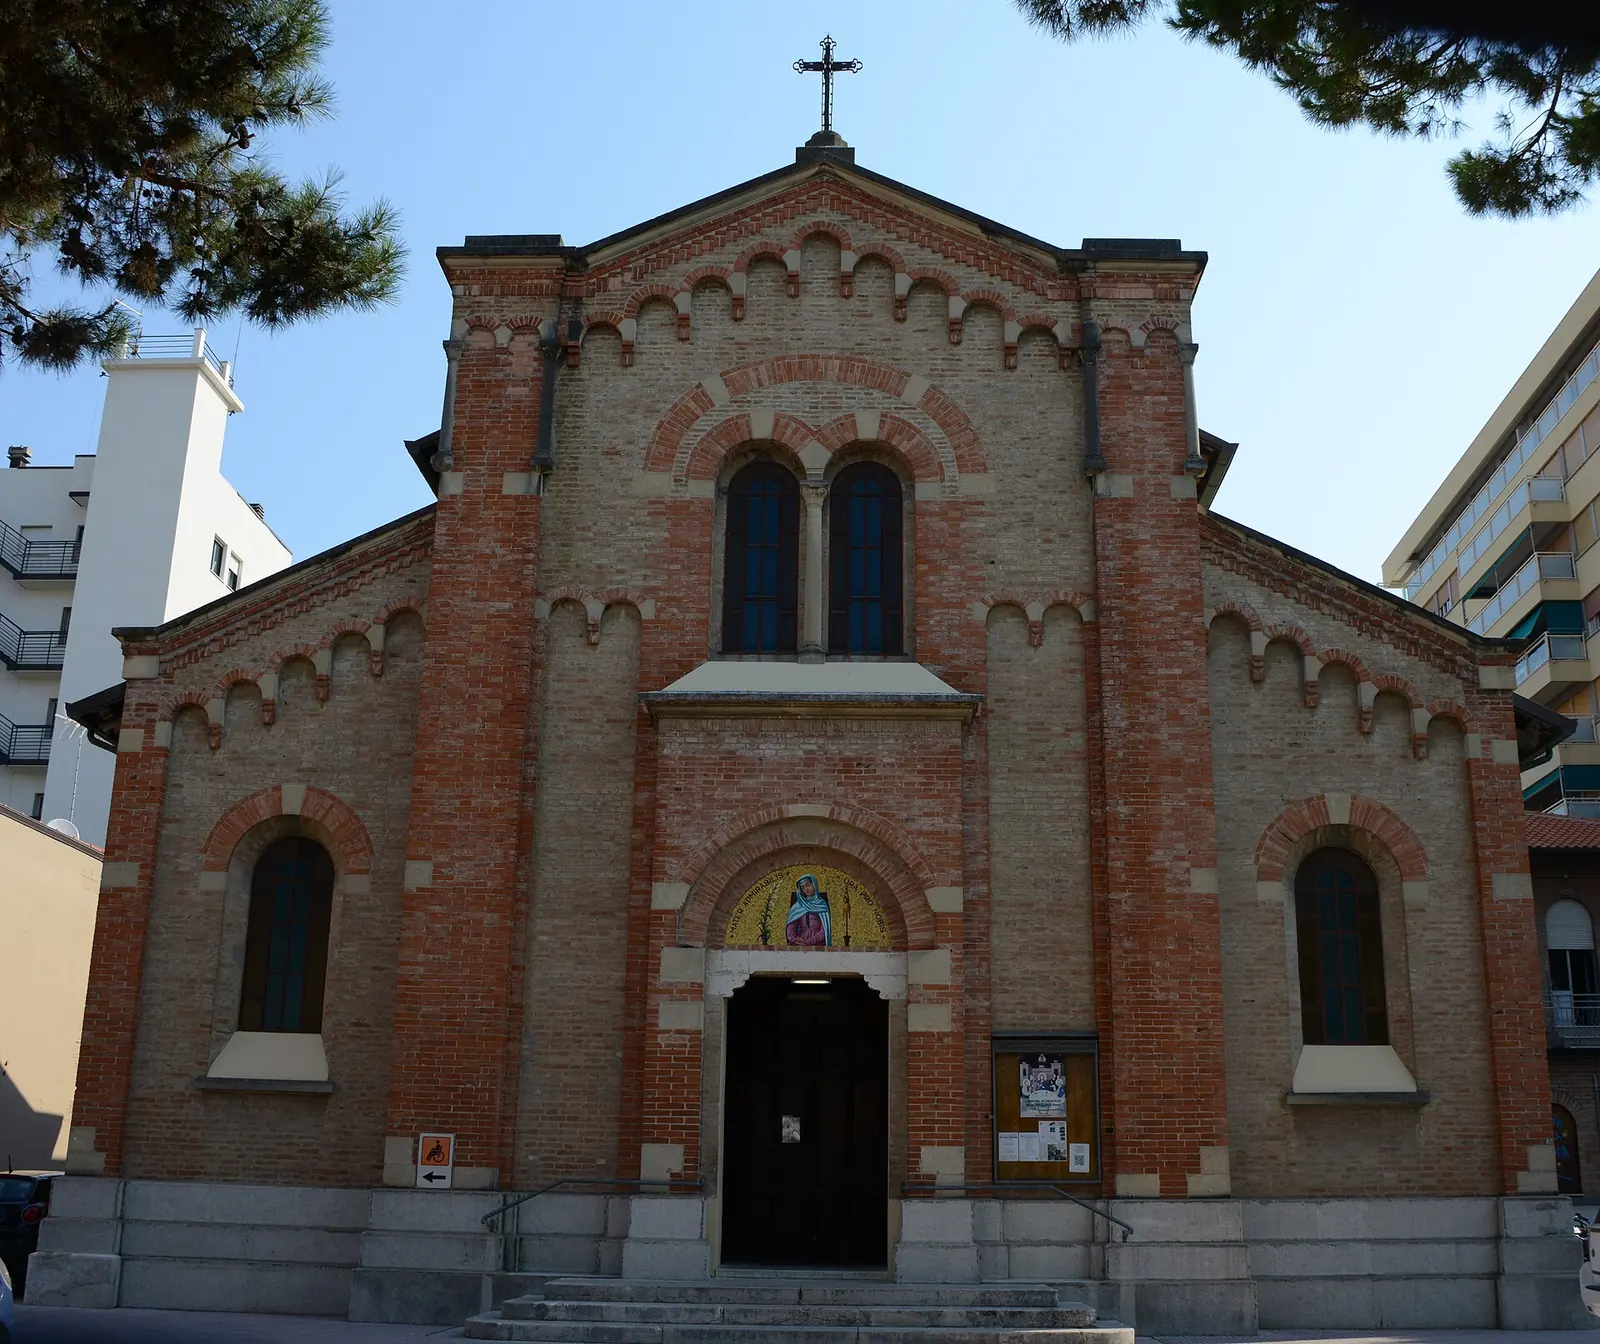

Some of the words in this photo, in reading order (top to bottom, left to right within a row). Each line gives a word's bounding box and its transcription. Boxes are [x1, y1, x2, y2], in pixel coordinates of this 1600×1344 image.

[730, 908, 744, 934] MATER
[742, 872, 784, 907] ADMIRABILIS
[843, 878, 858, 891] ORA
[860, 891, 874, 906] PRO
[872, 908, 887, 933] NOBIS
